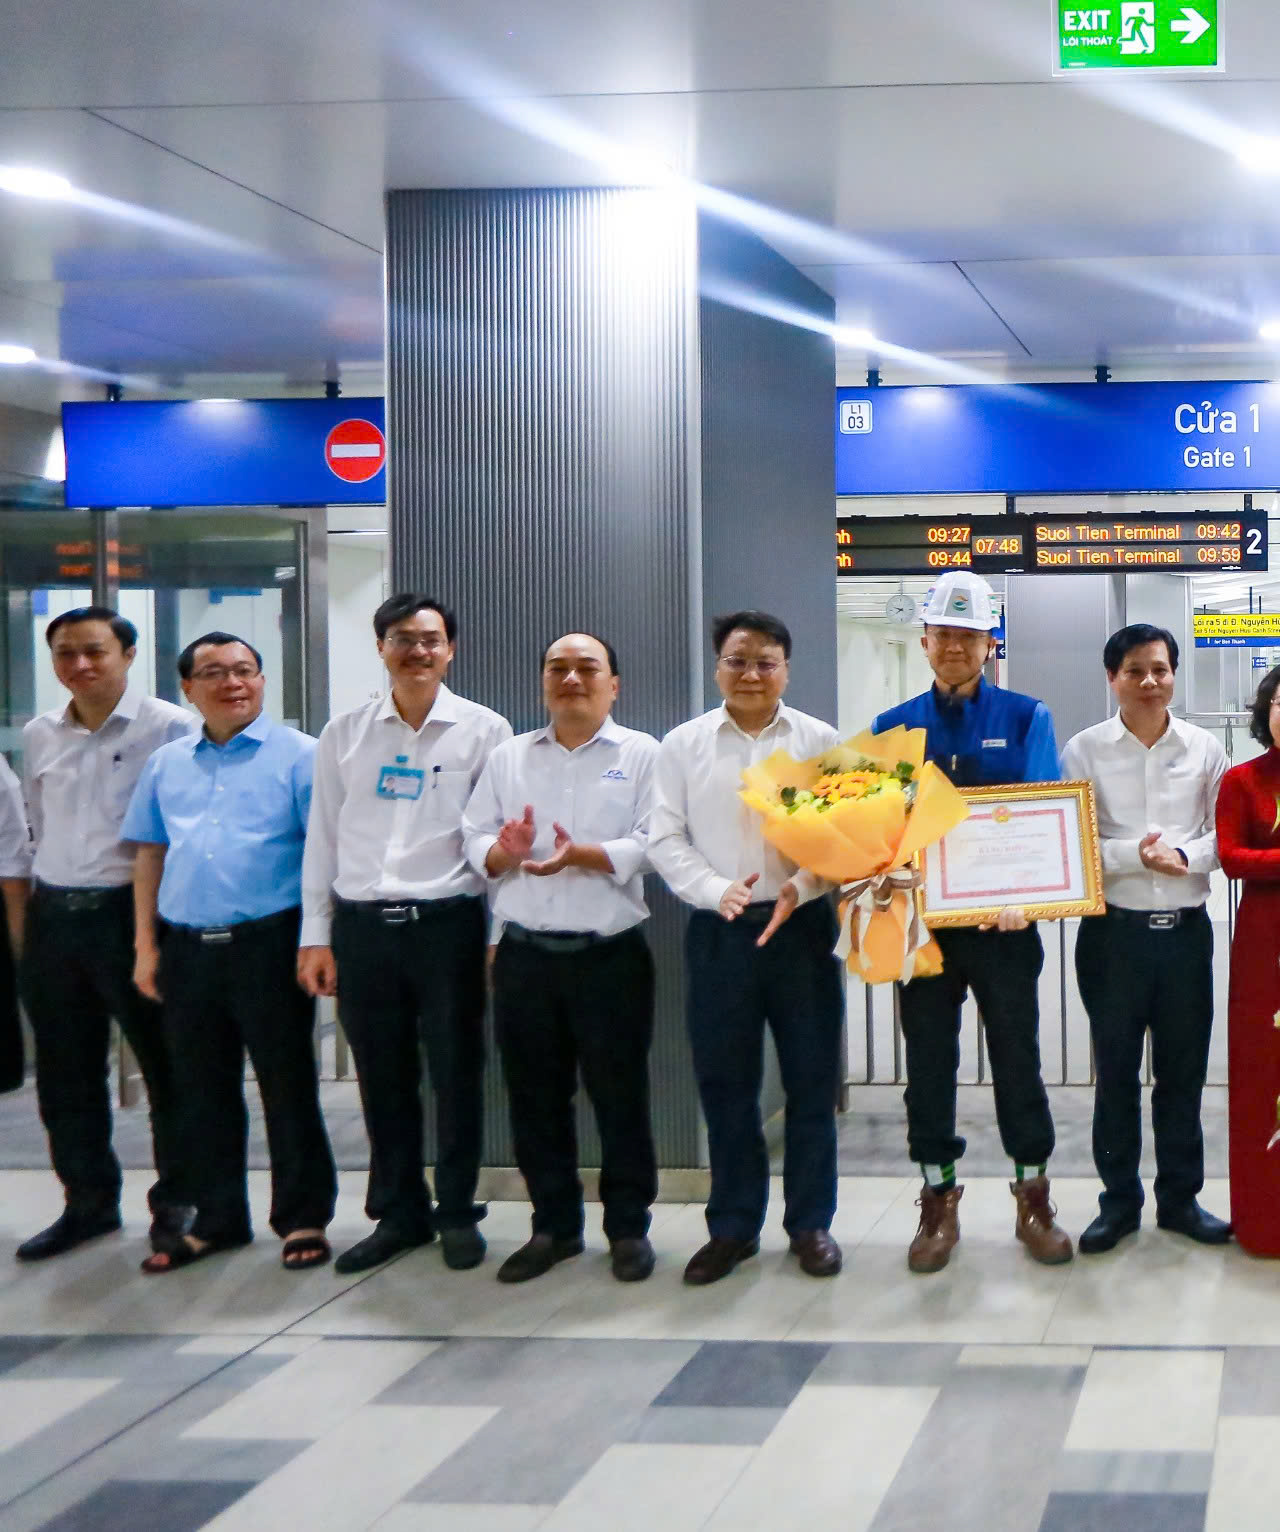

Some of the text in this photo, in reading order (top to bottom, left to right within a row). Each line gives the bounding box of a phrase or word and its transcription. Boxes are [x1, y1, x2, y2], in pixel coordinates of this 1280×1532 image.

[1063, 10, 1111, 31] EXIT
[1080, 36, 1113, 47] THOÁT
[850, 404, 861, 414] L1
[1174, 400, 1259, 434] Cửa 1
[848, 416, 864, 429] 03
[1183, 446, 1251, 468] Gate 1
[927, 527, 971, 543] 09:27
[1036, 524, 1241, 541] Suoi Tien Terminal 09:42
[975, 539, 1019, 554] 07:48
[1246, 529, 1262, 554] 2
[928, 551, 972, 566] 09:44
[1036, 548, 1241, 564] Suoi Tien Terminal 09:59
[1215, 618, 1221, 626] 5
